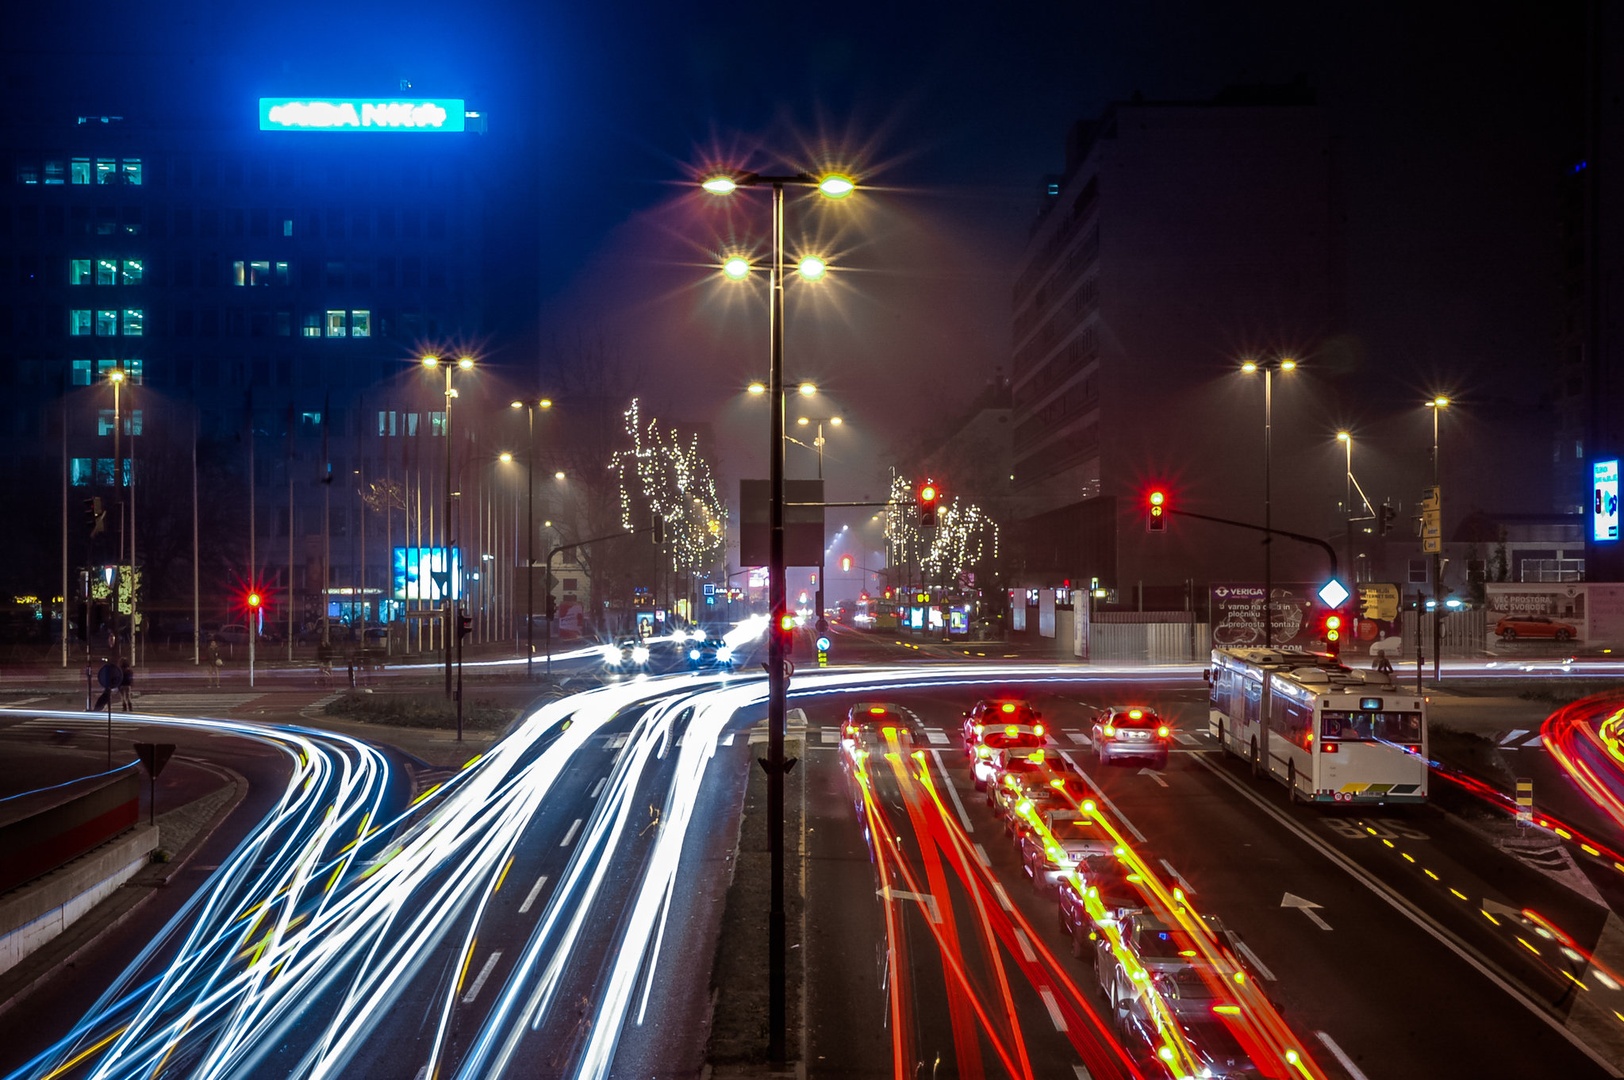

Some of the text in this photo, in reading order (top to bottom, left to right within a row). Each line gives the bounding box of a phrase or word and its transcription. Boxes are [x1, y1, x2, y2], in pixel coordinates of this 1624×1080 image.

[1230, 588, 1263, 596] VERIGA
[1510, 603, 1546, 611] SVOBODE
[1227, 610, 1261, 618] pločniku
